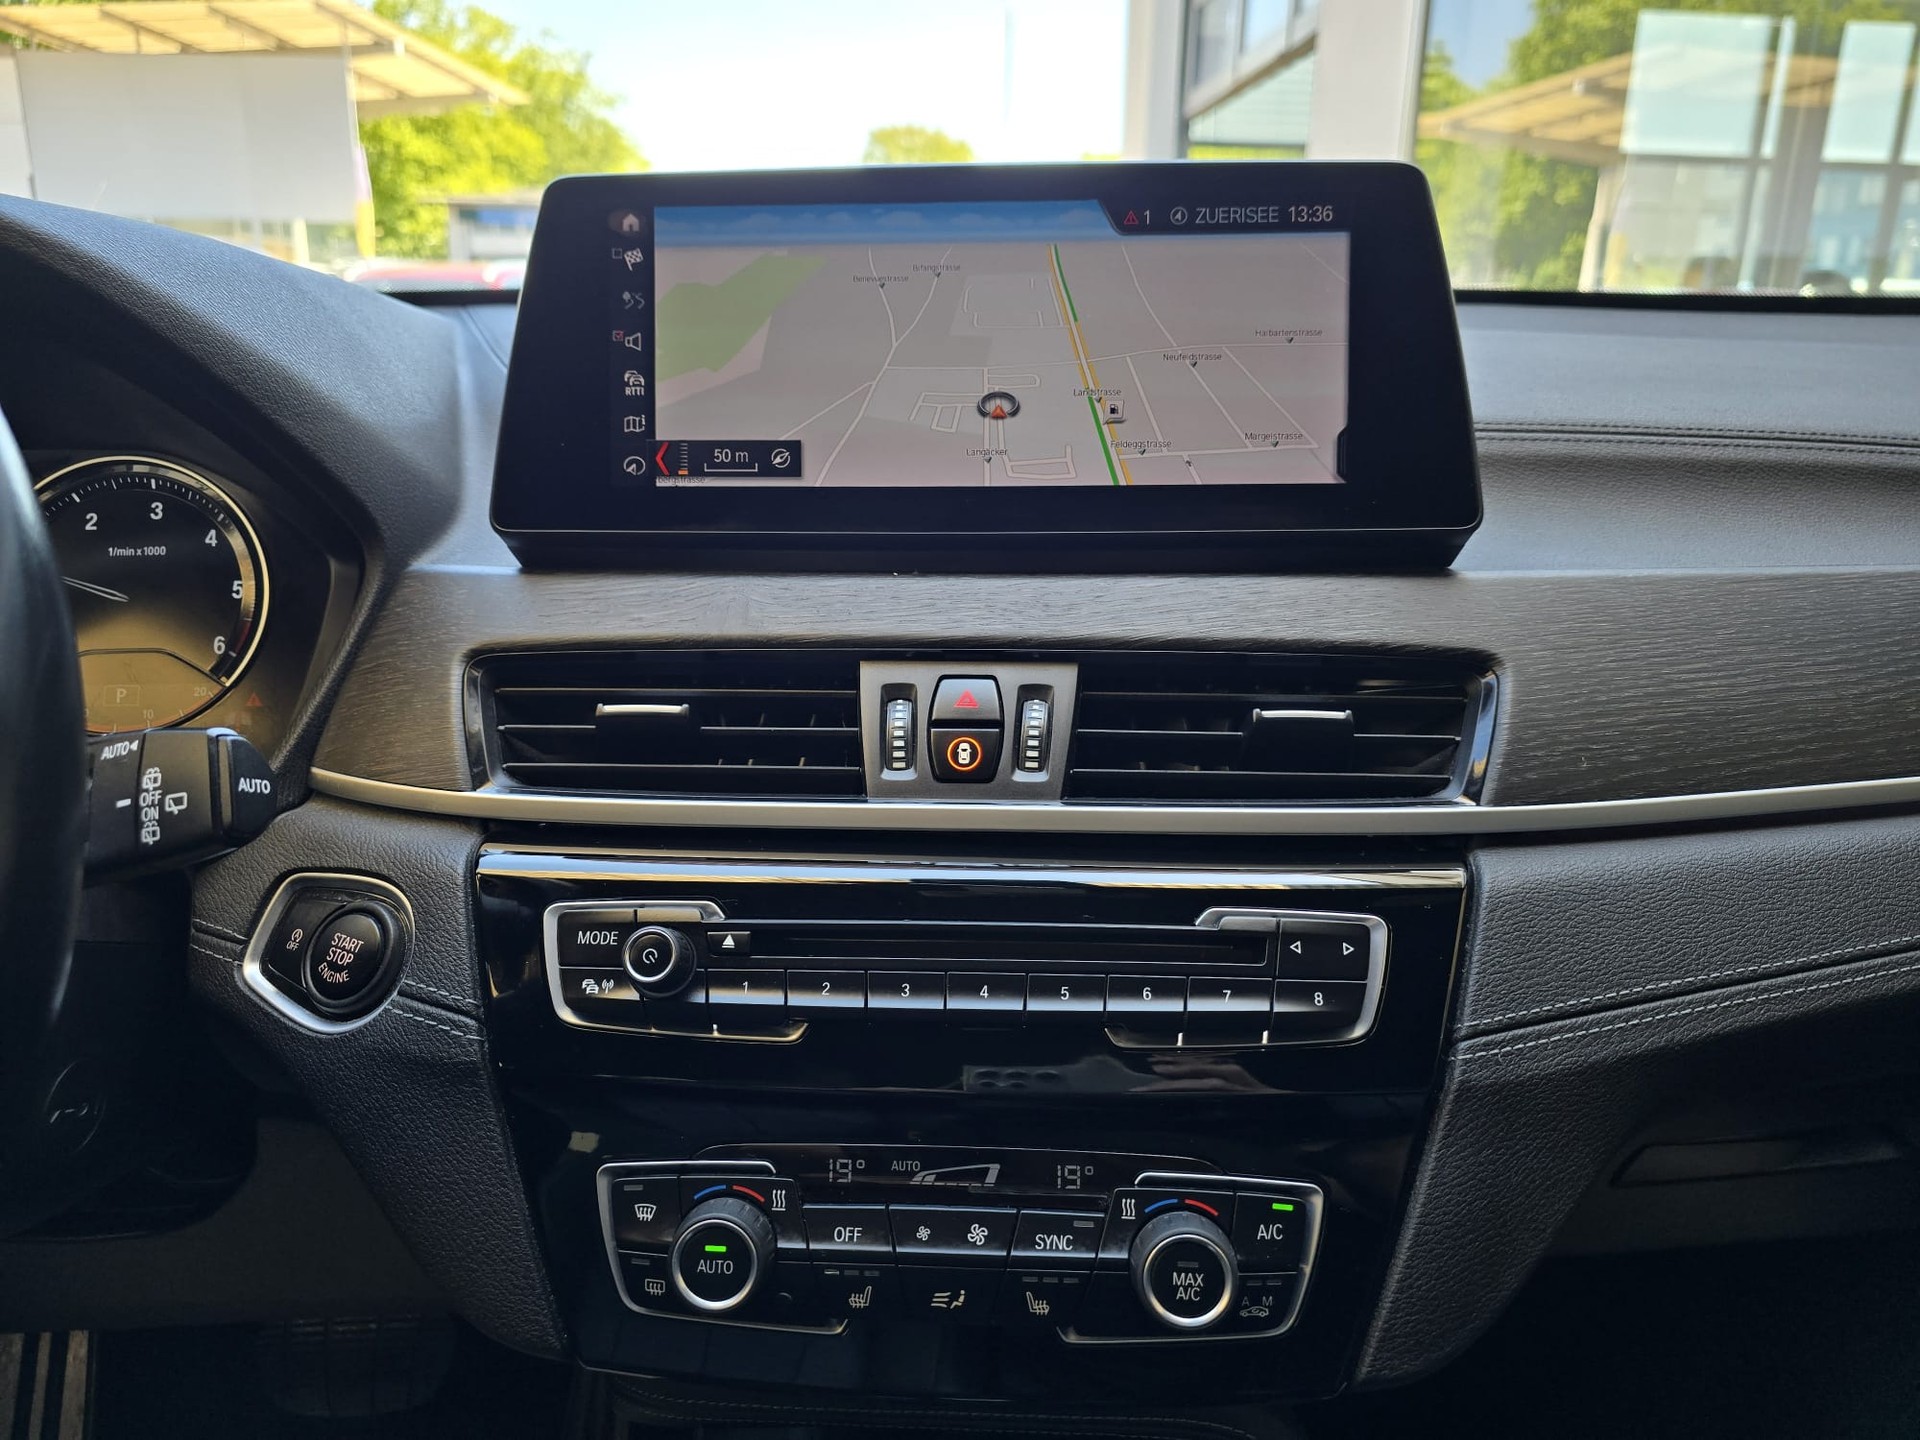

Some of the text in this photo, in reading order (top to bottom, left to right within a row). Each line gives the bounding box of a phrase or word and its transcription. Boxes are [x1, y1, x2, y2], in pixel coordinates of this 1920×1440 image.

[1143, 209, 1150, 225] 1
[1194, 205, 1333, 224] ZUERISEE 13:36
[1162, 353, 1222, 361] Neufeldstrasse
[625, 387, 645, 396] RTTI
[1110, 440, 1172, 449] Feldeggstrasse
[714, 449, 748, 462] 50 m
[150, 502, 163, 520] 3
[85, 513, 98, 530] 2
[205, 529, 217, 547] 4
[107, 547, 135, 557] 1/min
[143, 546, 166, 556] 1000
[231, 580, 243, 599] 5
[213, 636, 226, 655] 6
[116, 688, 127, 704] P
[142, 709, 154, 720] 10
[101, 741, 130, 760] AUTO
[238, 777, 271, 794] AUTO
[139, 790, 162, 807] OFF
[141, 806, 159, 821] ON
[286, 941, 300, 951] OFF
[331, 932, 364, 953] START
[577, 931, 619, 946] MODE
[326, 947, 354, 967] STOP
[318, 962, 350, 984] ENGINE
[741, 981, 1324, 1006] 1 2 3 4 5 6 7 8
[891, 1160, 920, 1172] AUTO
[834, 1227, 863, 1243] OFF
[1257, 1224, 1284, 1240] A/C
[1035, 1234, 1073, 1251] SYNC
[697, 1260, 734, 1275] AUTO
[1172, 1272, 1204, 1288] MAX
[1176, 1286, 1201, 1302] A/C
